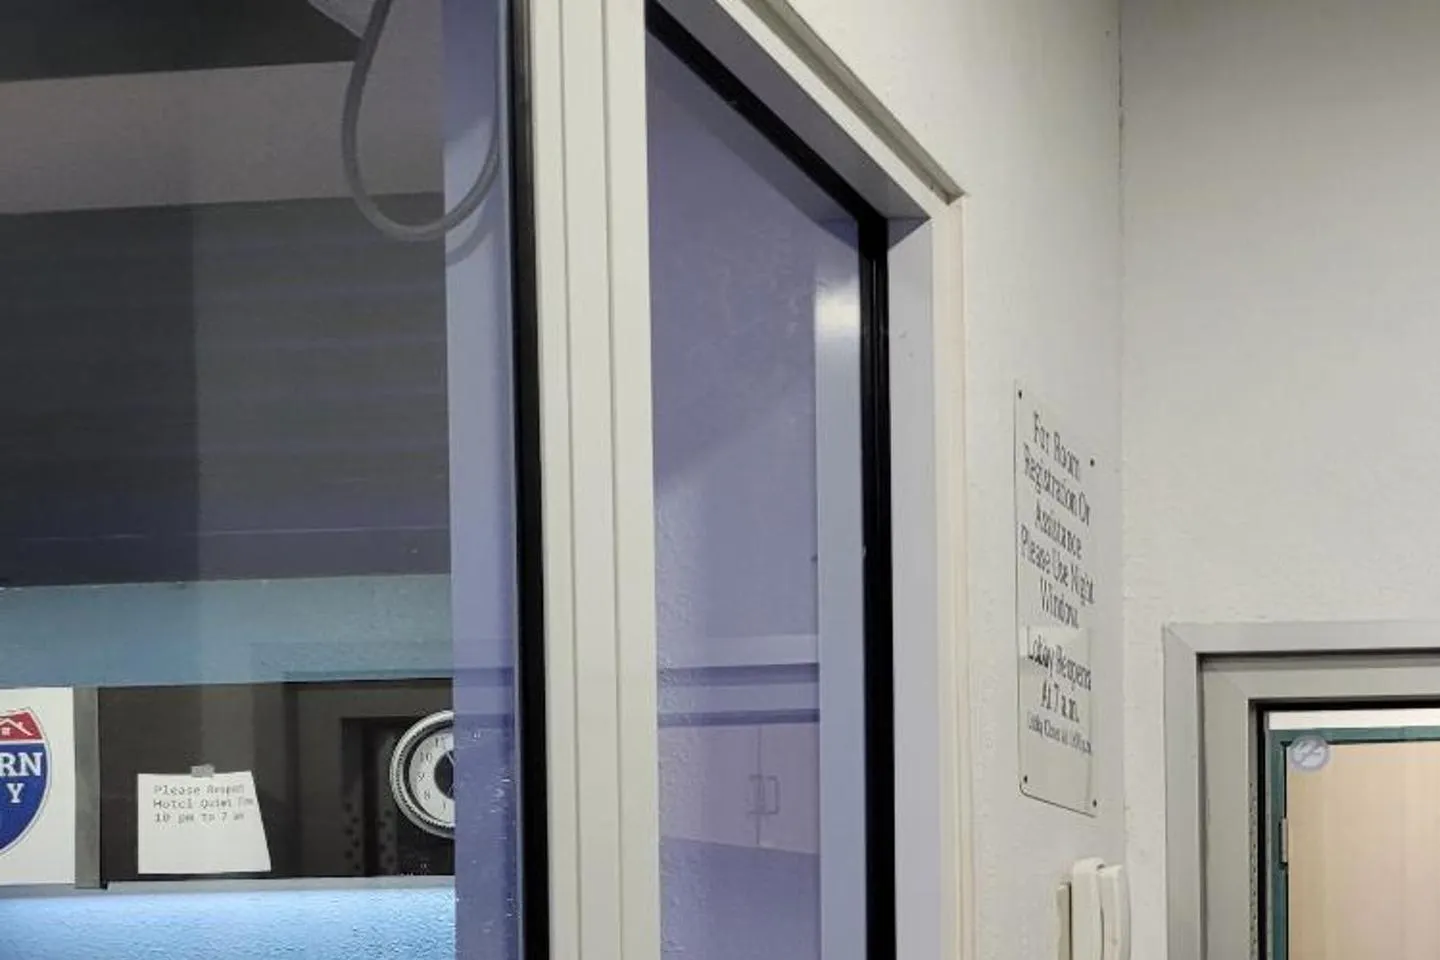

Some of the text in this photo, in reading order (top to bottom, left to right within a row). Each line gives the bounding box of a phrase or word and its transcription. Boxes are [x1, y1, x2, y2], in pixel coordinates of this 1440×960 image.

[1033, 410, 1080, 481] For Room
[1023, 442, 1077, 516] Registration
[1034, 500, 1082, 560] Assistance
[153, 784, 201, 796] Please
[153, 798, 193, 809] Hotel
[154, 813, 171, 823] 10
